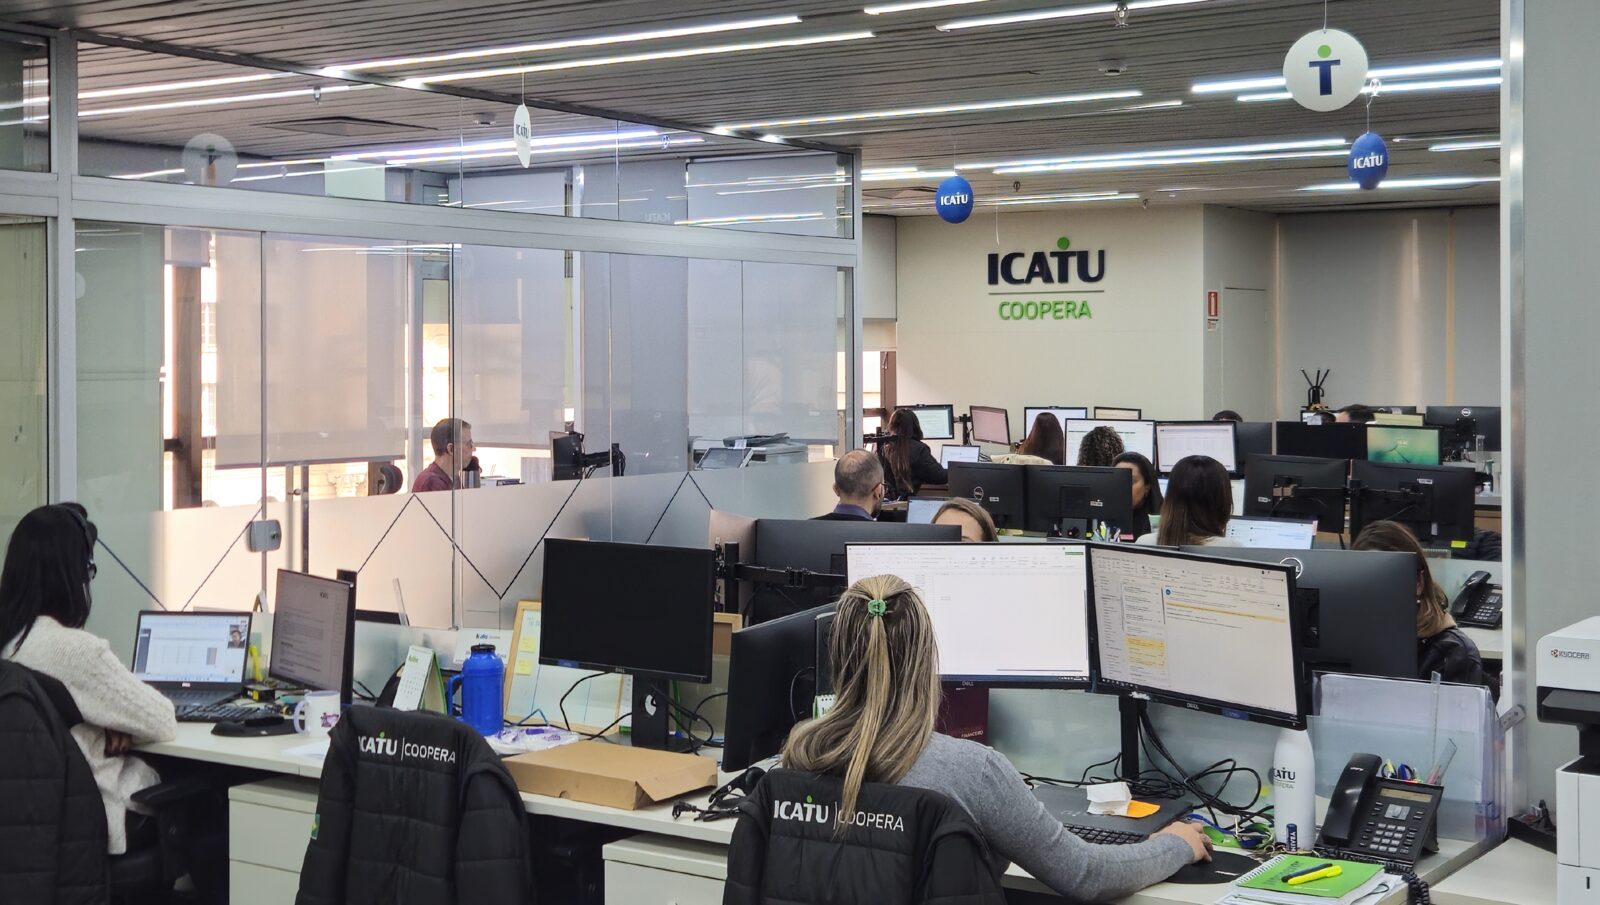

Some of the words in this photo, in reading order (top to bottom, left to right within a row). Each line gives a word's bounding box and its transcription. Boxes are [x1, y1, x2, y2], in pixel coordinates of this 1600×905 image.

[1353, 152, 1384, 169] ICATU
[940, 191, 968, 206] ICATU
[987, 236, 1105, 285] ICATU
[998, 300, 1092, 320] COOPERA
[1558, 650, 1590, 660] KYOCERA
[404, 742, 456, 764] COOPERA
[773, 795, 829, 823] ICATU
